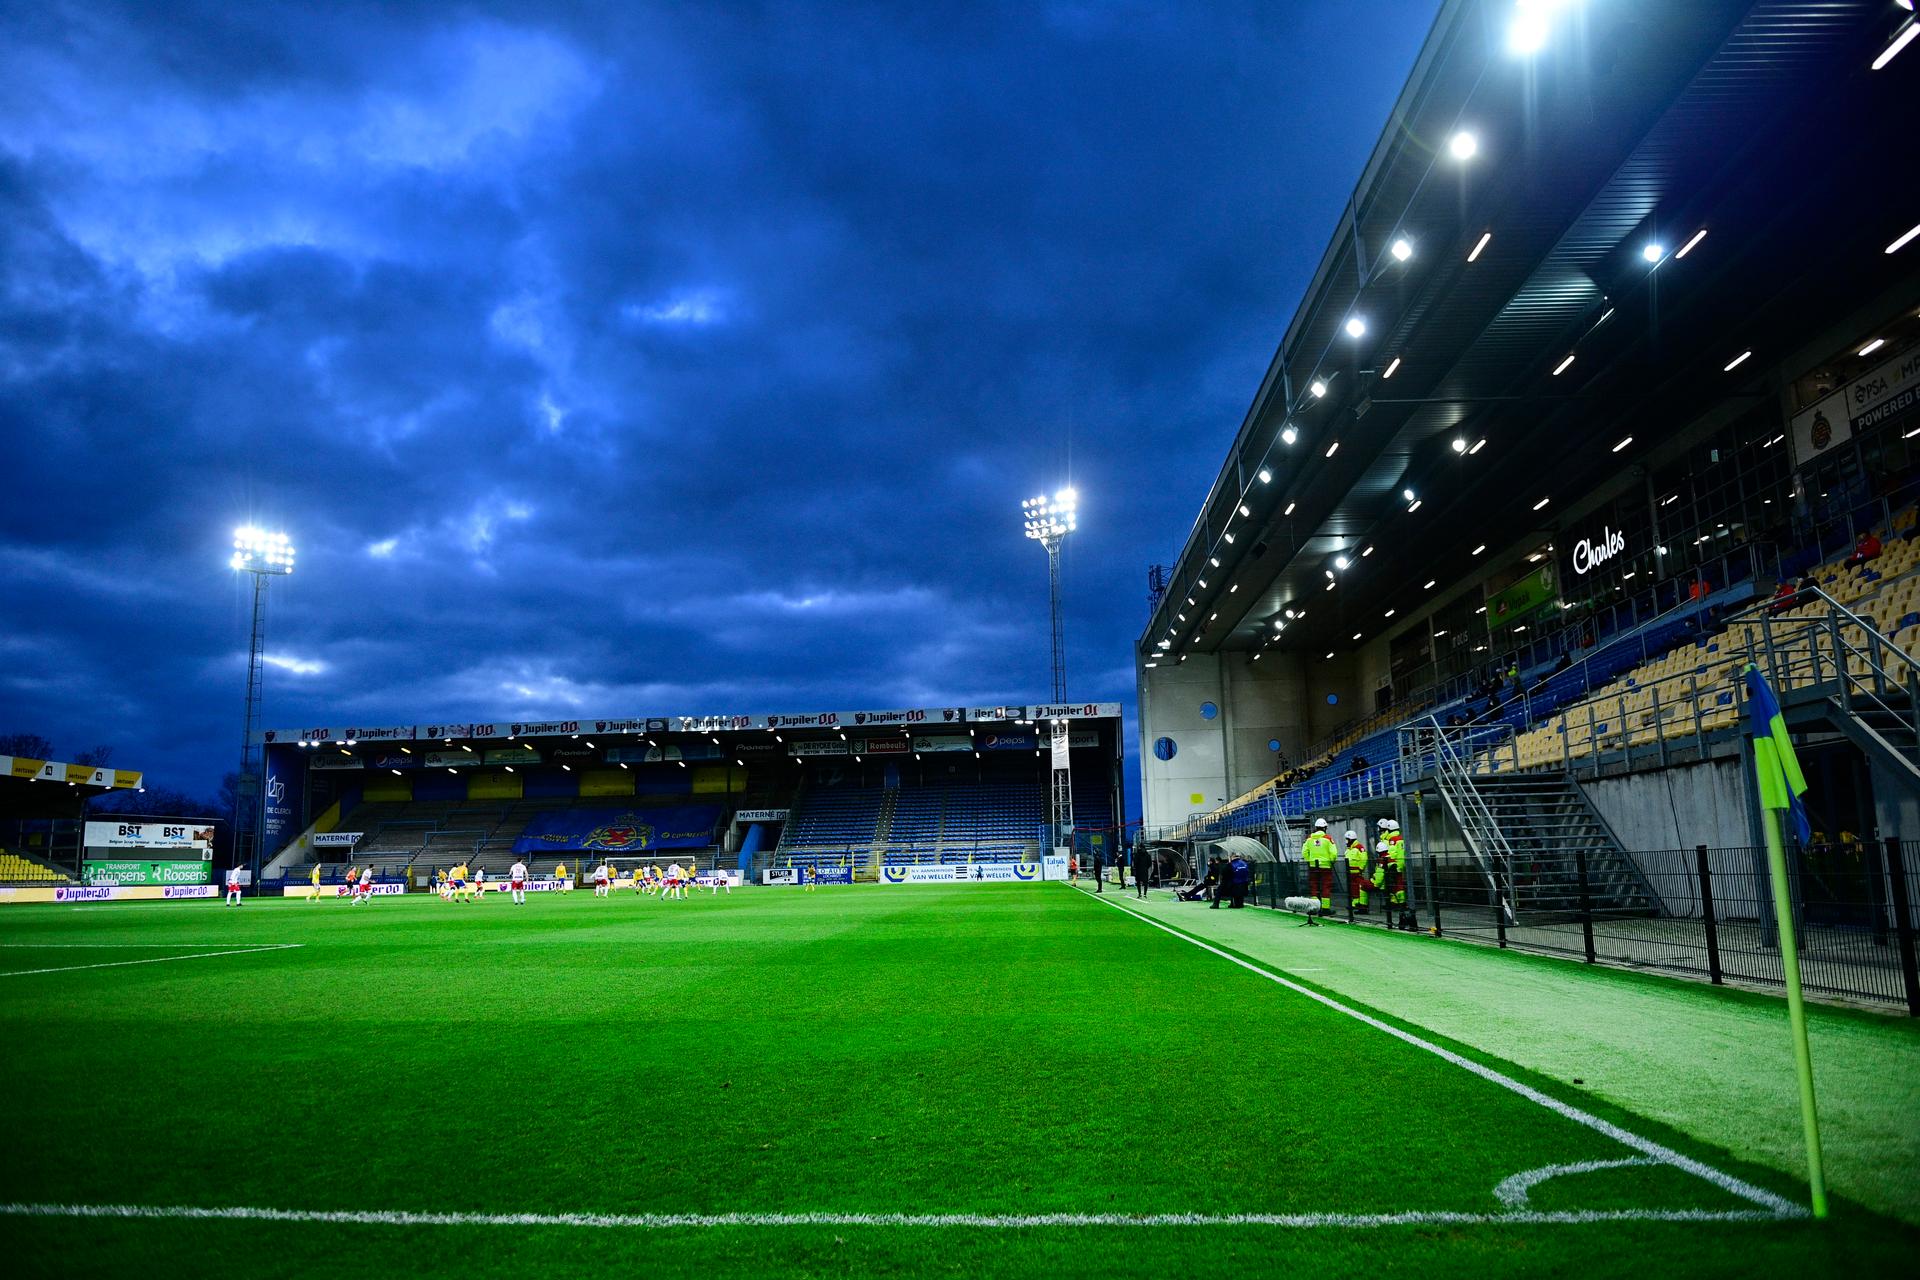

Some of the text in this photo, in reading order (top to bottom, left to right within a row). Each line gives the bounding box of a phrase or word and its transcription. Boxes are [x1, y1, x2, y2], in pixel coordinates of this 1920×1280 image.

[1858, 391, 1913, 430] POWERED
[1573, 525, 1625, 575] Charles
[868, 711, 905, 723] Jupiler
[1044, 706, 1083, 717] Jupiler
[608, 719, 644, 731] Jupiler
[780, 714, 818, 726] Jupiler
[357, 728, 392, 739] Jupiler
[524, 723, 559, 734] Jupiler
[999, 736, 1025, 746] pepsi
[118, 825, 142, 836] BST
[163, 826, 185, 837] BST
[98, 868, 146, 882] Roosens
[164, 868, 208, 881] Roosens
[64, 888, 97, 901] Jupiler
[171, 886, 197, 898] Jupiler
